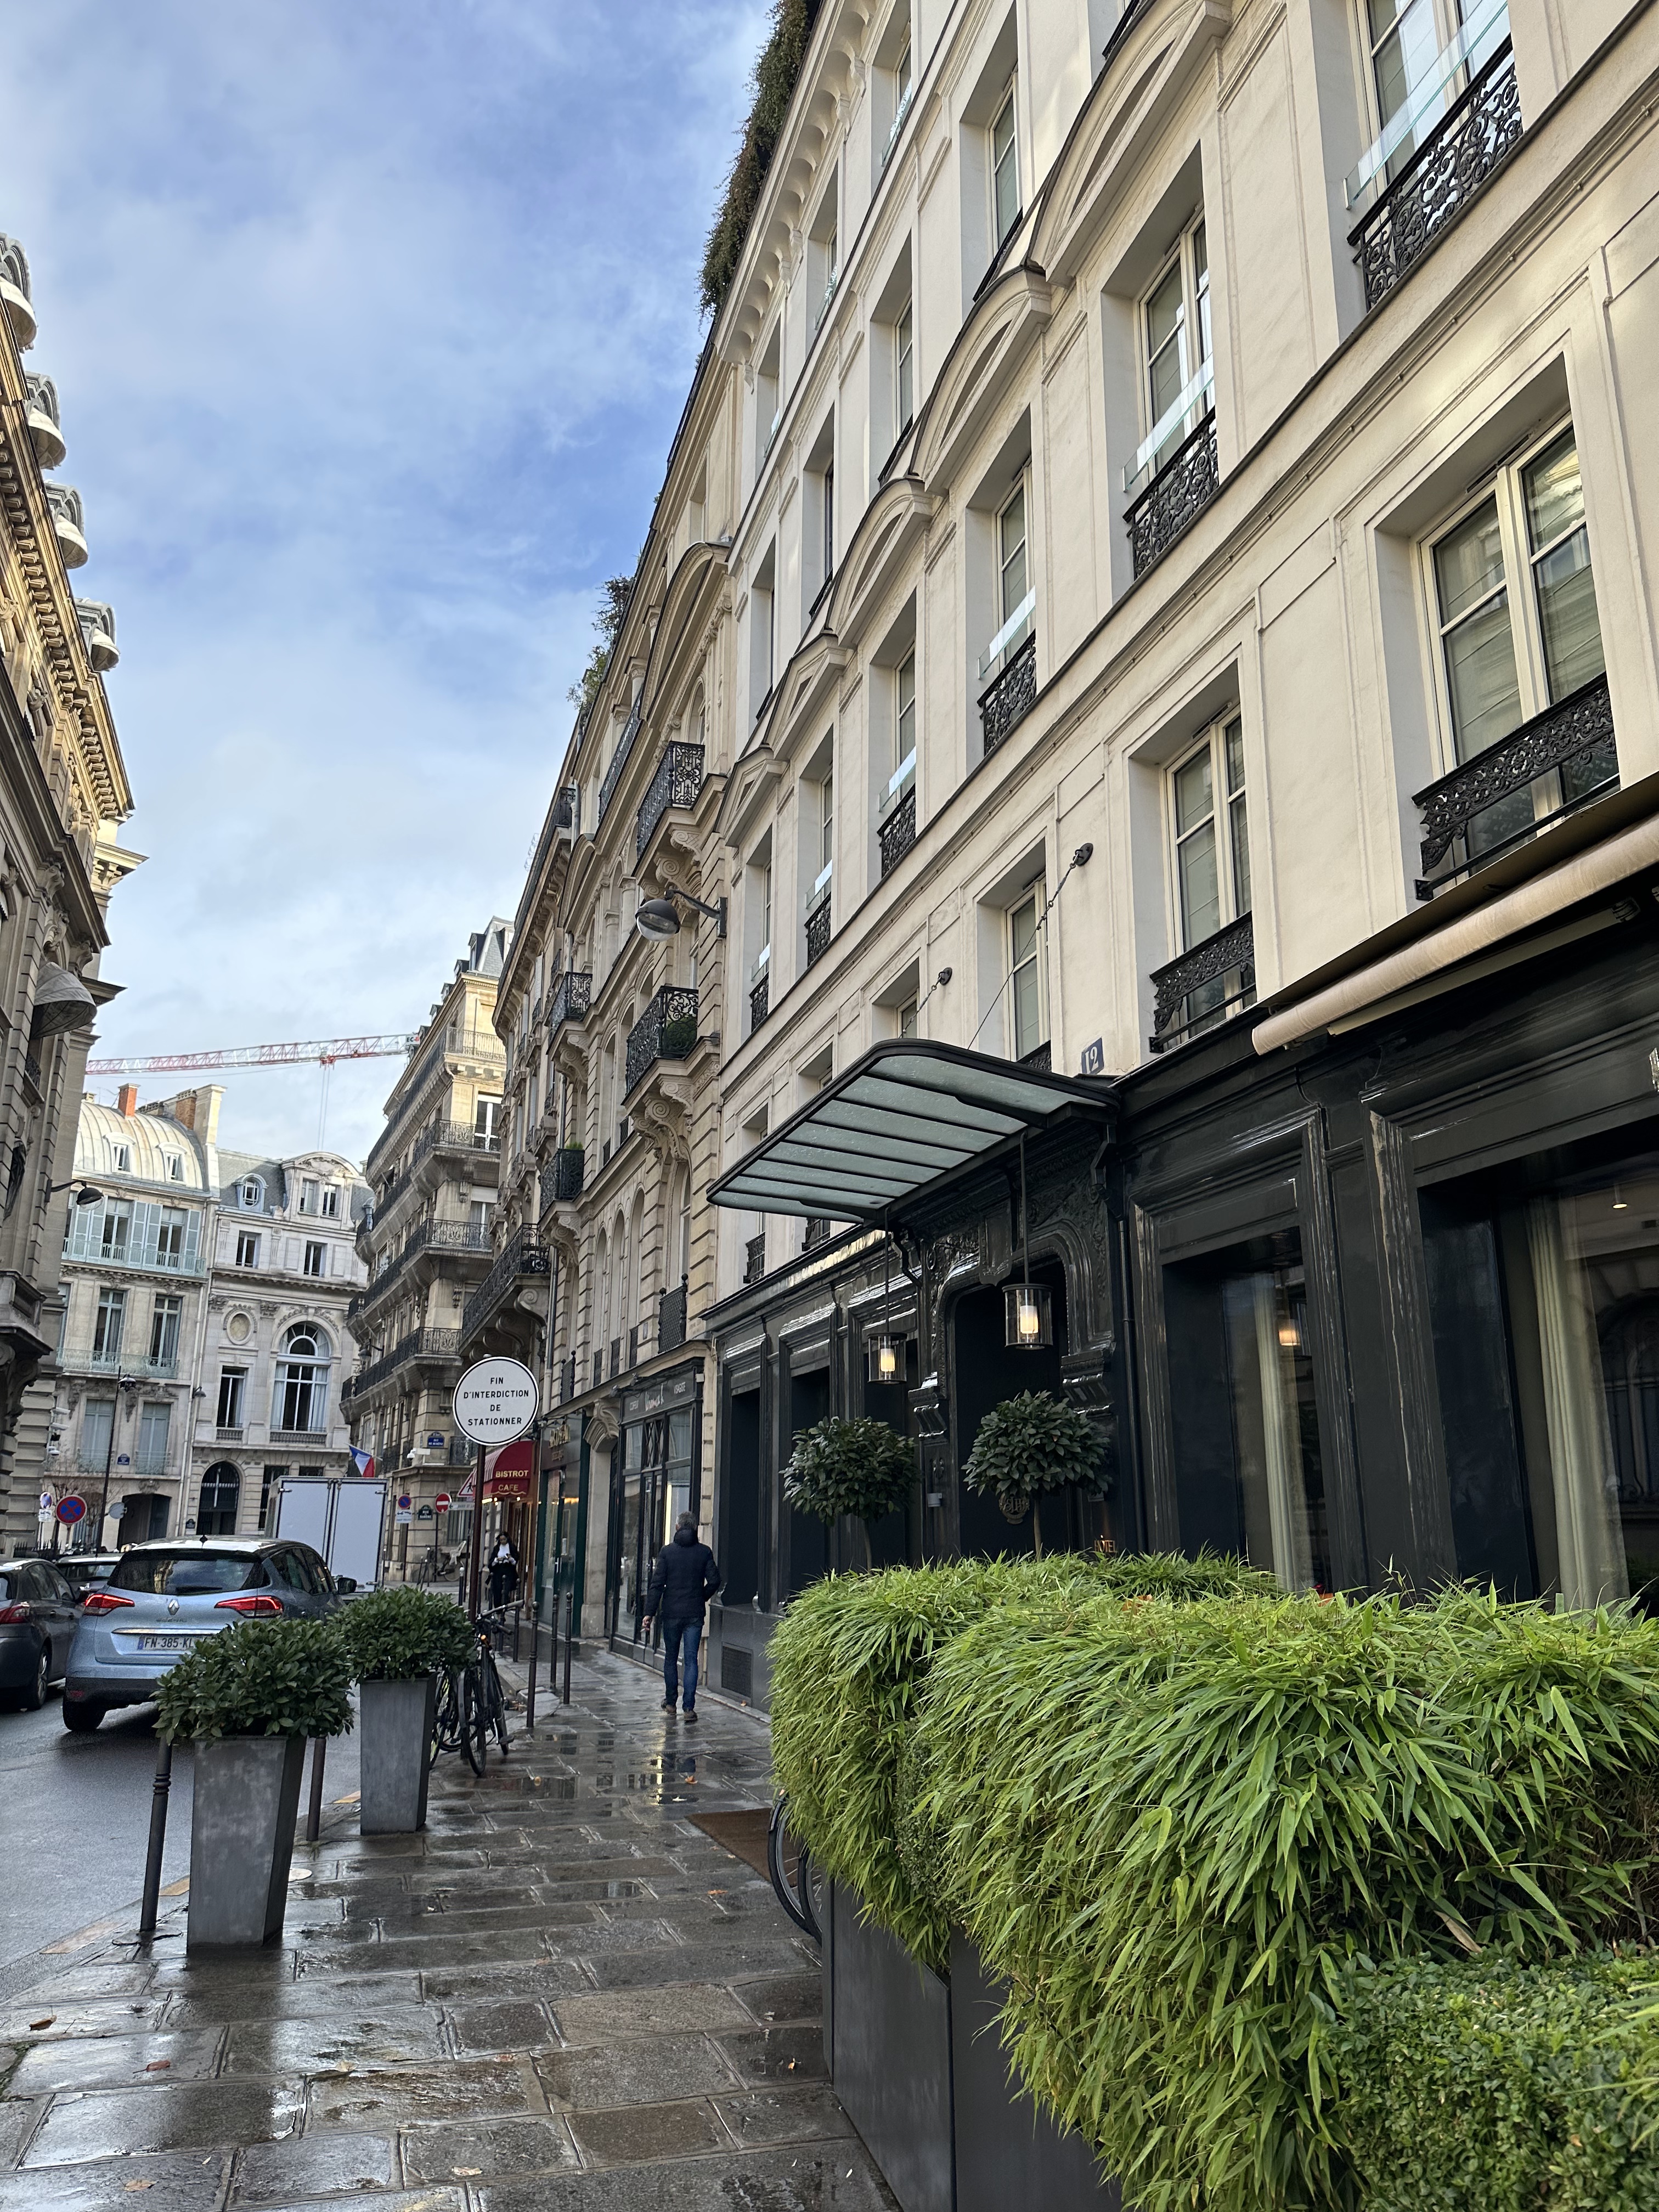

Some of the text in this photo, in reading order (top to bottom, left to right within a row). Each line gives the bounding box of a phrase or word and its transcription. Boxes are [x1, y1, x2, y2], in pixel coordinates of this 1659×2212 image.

[1085, 1046, 1098, 1074] 12
[464, 1390, 529, 1399] D'INTERDICTION
[468, 1417, 522, 1426] STATIONNER
[144, 1637, 194, 1649] FN-385-KL
